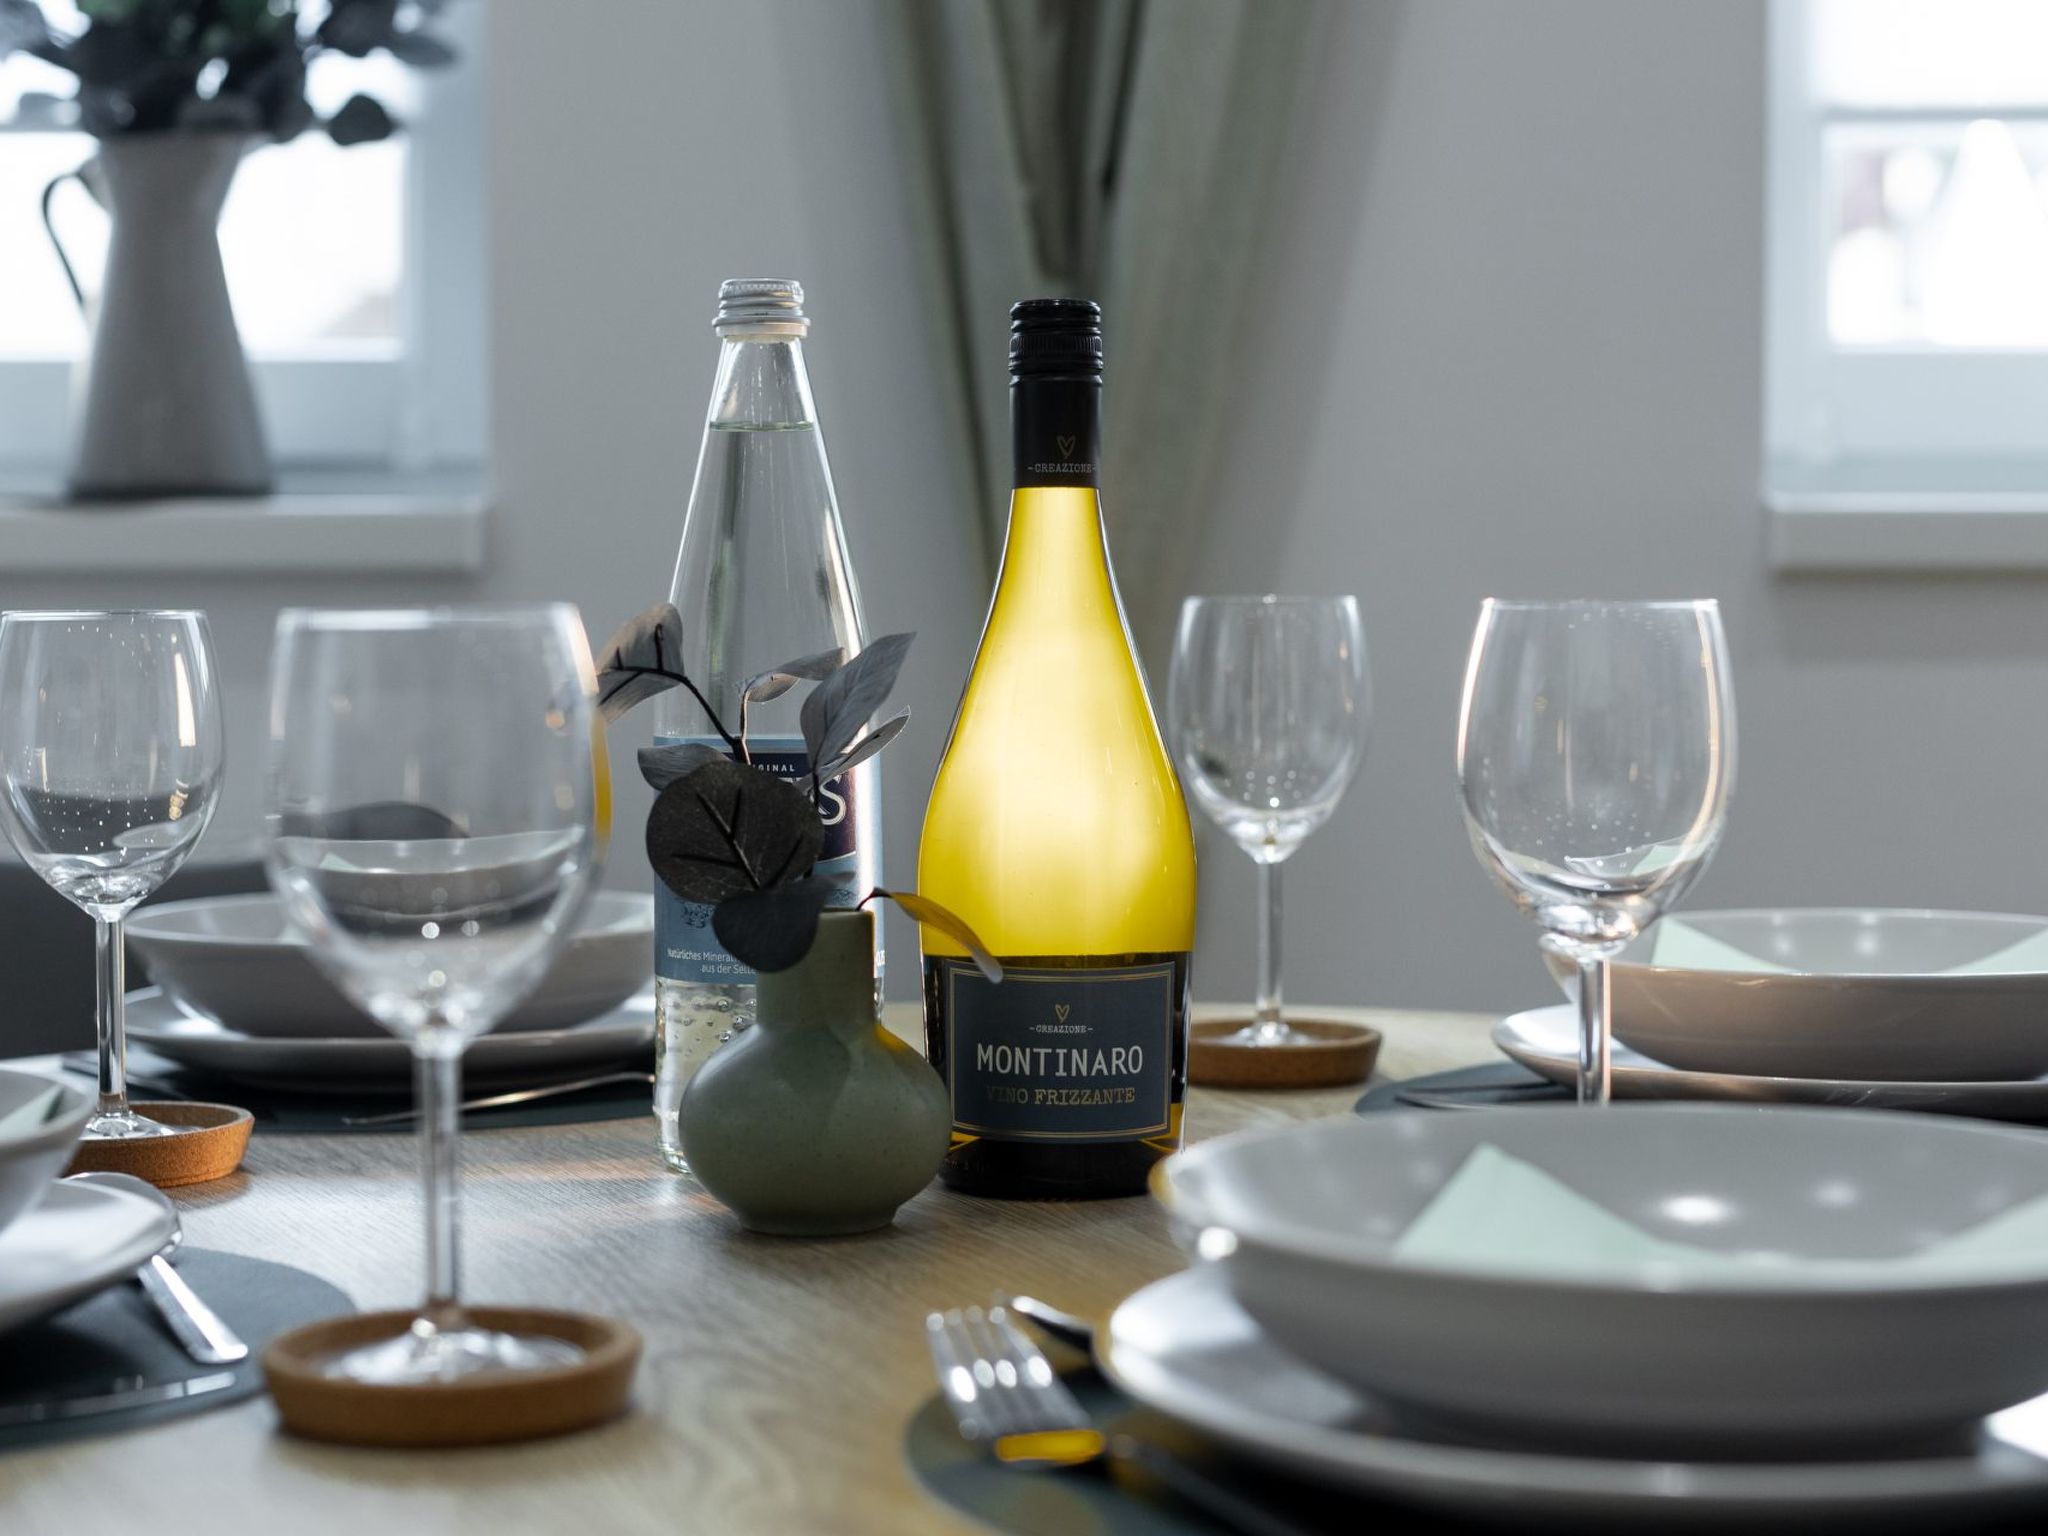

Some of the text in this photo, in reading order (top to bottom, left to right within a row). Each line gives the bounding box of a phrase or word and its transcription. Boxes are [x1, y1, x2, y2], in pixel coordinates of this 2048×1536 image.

[701, 964, 715, 974] aus
[717, 963, 731, 974] der
[977, 1043, 1143, 1077] MONTINARO
[987, 1085, 1136, 1105] VINO FRIZZANTE
